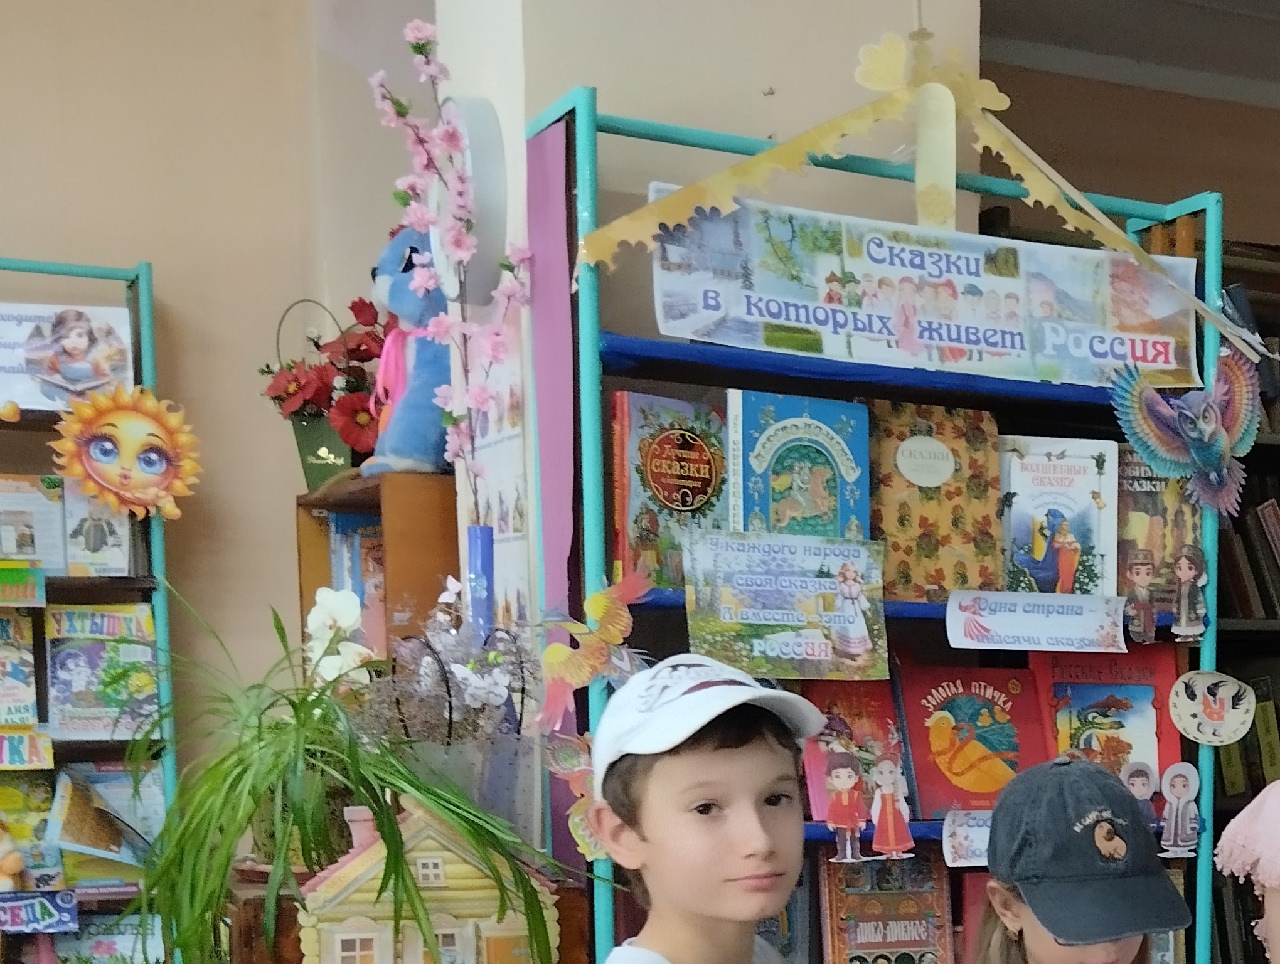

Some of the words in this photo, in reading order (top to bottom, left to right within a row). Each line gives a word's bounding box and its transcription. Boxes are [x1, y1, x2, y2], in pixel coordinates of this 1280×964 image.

[866, 237, 982, 279] Сказки
[702, 288, 722, 312] в
[745, 294, 897, 337] которых
[917, 318, 1027, 351] живет
[1042, 320, 1173, 366] Россия
[802, 544, 862, 561] народа
[735, 574, 775, 590] своя
[779, 577, 839, 593] сказка
[739, 608, 806, 624] вместе
[978, 597, 1018, 615] Одна
[1022, 601, 1085, 618] страна
[920, 678, 965, 713] ЗОЛОТАЯ
[970, 680, 1014, 713] ПТИЧКА
